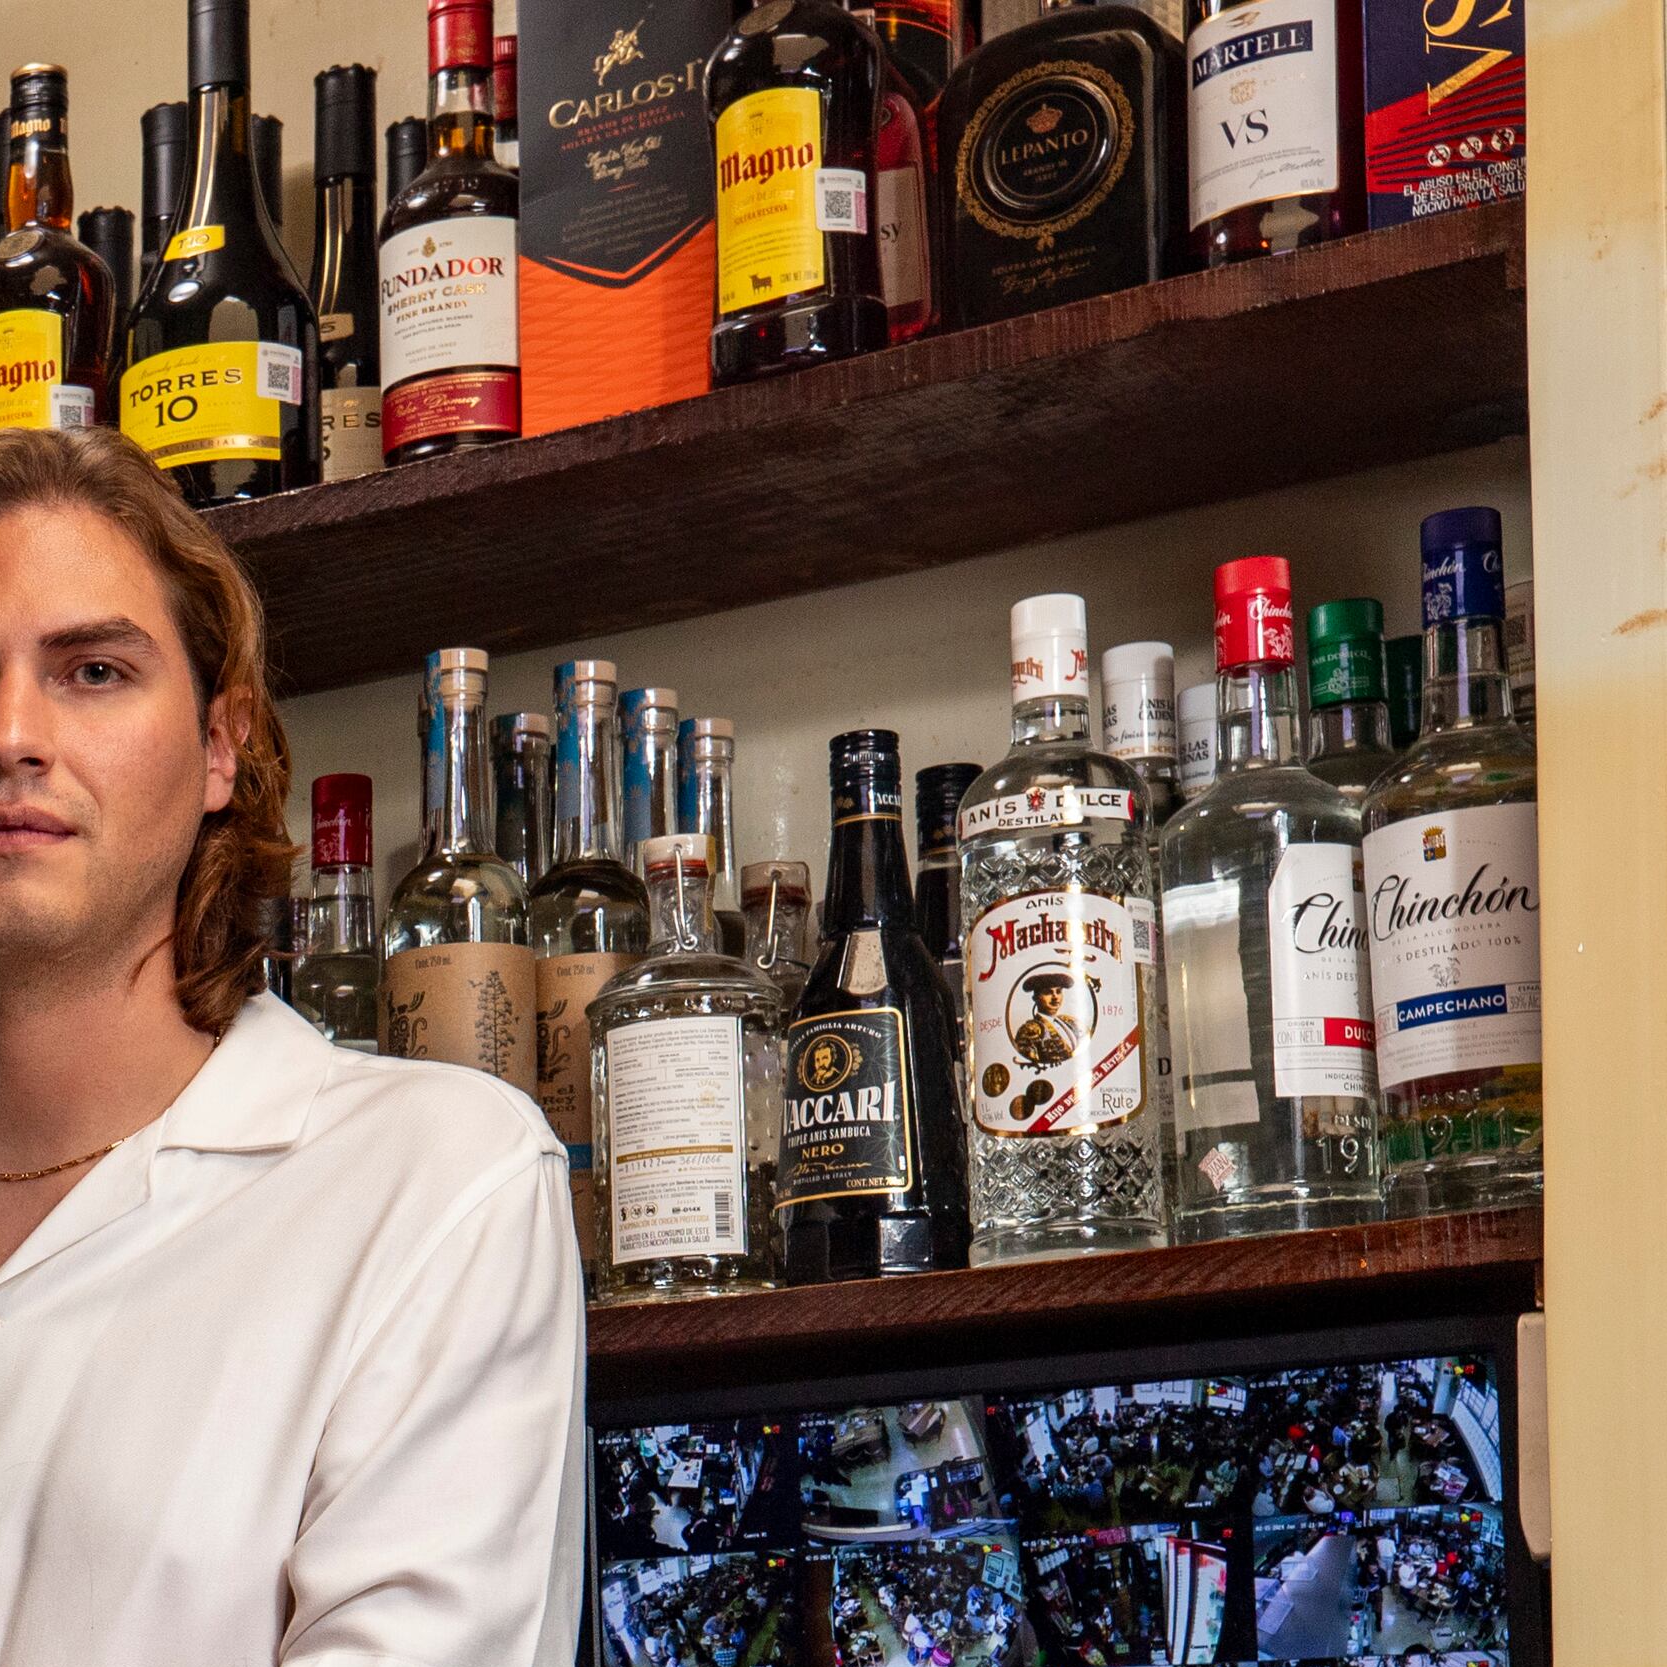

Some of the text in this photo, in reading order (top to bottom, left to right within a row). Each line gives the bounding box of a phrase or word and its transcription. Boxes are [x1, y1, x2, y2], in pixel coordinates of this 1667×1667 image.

[1195, 28, 1305, 77] MARTELL
[1218, 109, 1269, 150] VS
[1001, 129, 1088, 165] LEPANTO
[720, 142, 814, 194] Magno
[1404, 168, 1485, 197] EL ABUSO EN EL
[1412, 187, 1497, 217] NOCIVO PARA LA
[1413, 174, 1515, 205] DE ESTE PRODUCTO
[381, 257, 504, 305] FUNDADOR
[387, 283, 486, 316] SHERRY CASK
[130, 368, 242, 408] TORRES
[154, 395, 198, 429] 10
[1139, 699, 1165, 712] ANIS
[967, 796, 1017, 826] ANÍS
[998, 813, 1064, 827] DESTILA
[1025, 895, 1064, 910] ANÍS
[1373, 863, 1538, 941] Chinchón
[1405, 935, 1521, 962] DESTILADO 100%
[1102, 1006, 1124, 1016] 1876
[1398, 994, 1505, 1023] CAMPECHANO
[806, 1022, 882, 1039] FAMIGLIA ARTURO
[1102, 1093, 1134, 1114] Rute
[829, 1125, 872, 1140] SAMBUCA
[802, 1143, 844, 1159] NERO
